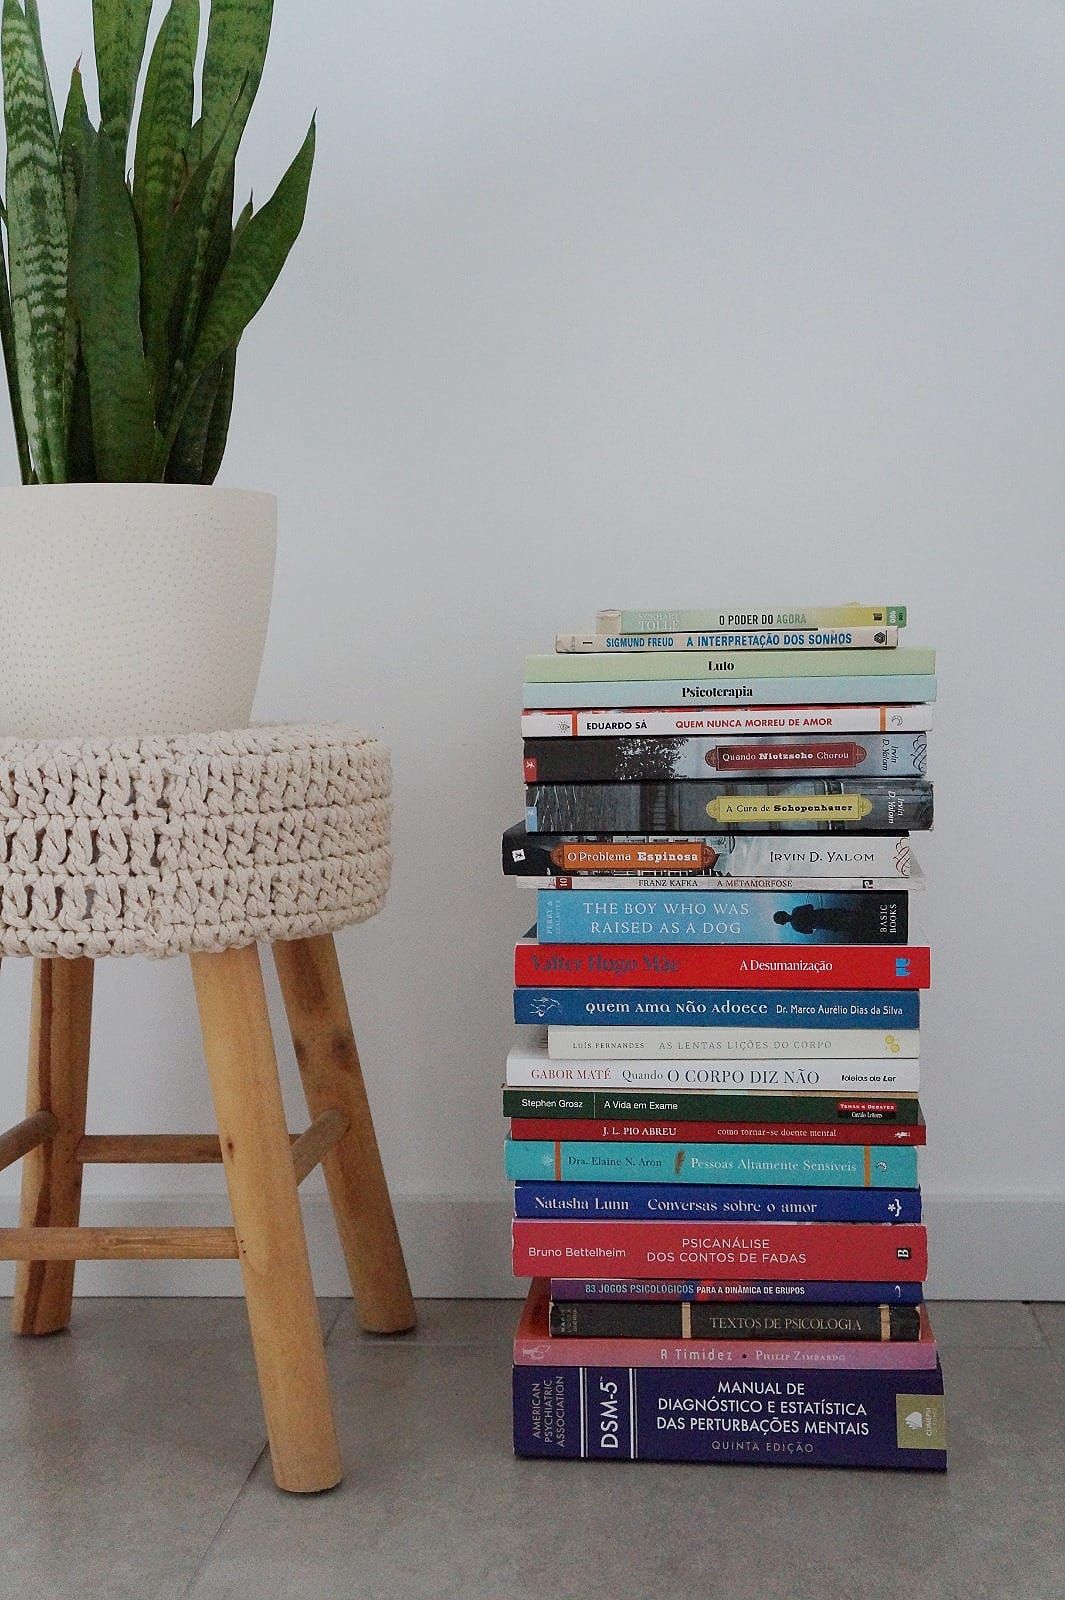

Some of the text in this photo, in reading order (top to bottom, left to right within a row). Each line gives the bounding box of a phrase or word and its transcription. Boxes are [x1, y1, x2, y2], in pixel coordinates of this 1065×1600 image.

[719, 613, 807, 625] O PODER DO AGORA
[606, 632, 852, 648] SIGMUND FREUD A INTERPRETAÇÃO DOS SONHOS
[708, 660, 735, 671] Luto
[682, 686, 753, 698] Psicoterapia
[586, 718, 647, 730] EDUARDO SÁ
[675, 717, 833, 729] QUEM NUNCA MORREU DE AMOR
[722, 749, 849, 763] Quando Nietzsche Chorou
[887, 792, 895, 800] D.
[726, 802, 853, 813] A Cura de Schopenhauer
[568, 849, 699, 862] O Problema Espinosa
[809, 850, 822, 863] D.
[726, 879, 793, 887] METAMORFOSE
[584, 902, 749, 914] THE BOY WHO WAS
[591, 922, 741, 934] RAISED AS A DOG
[740, 958, 833, 973] A Desumanização
[776, 1003, 903, 1016] Dr. Marco Aurélio Dias da Silva
[573, 1040, 592, 1049] LUÍS
[659, 1040, 832, 1051] AS LENTAS LIÇÕES DO CORPO
[531, 1067, 611, 1080] GABOR MATÉ
[622, 1067, 820, 1084] Quando O CORPO DIZ NÃO
[522, 1098, 583, 1110] Stephen Grosz
[604, 1100, 611, 1110] A
[613, 1100, 631, 1110] Vida
[650, 1101, 678, 1111] Exame
[602, 1126, 676, 1136] J. L. PIO ABREU
[810, 1128, 836, 1137] mental
[568, 1157, 662, 1167] Dra. Elaine N. Aron
[690, 1158, 856, 1172] Pessoas Altamente Sensíveis
[534, 1196, 629, 1210] Natasha Lunn
[648, 1198, 817, 1213] Conversas sobre o amor
[682, 1236, 770, 1249] PSICANÁLISE
[528, 1247, 626, 1258] Bruno Bettelheim
[647, 1252, 806, 1263] DOS CONTOS DE FADAS
[585, 1284, 596, 1294] 83
[598, 1283, 627, 1294] JOGOS
[696, 1285, 716, 1295] PARA
[718, 1285, 723, 1295] A
[725, 1283, 761, 1295] DINÂMICA
[764, 1285, 773, 1295] DE
[775, 1285, 805, 1295] GRUPOS
[710, 1317, 861, 1330] TEXTOS DE PSICOLOGIA
[660, 1349, 669, 1360] A
[675, 1348, 732, 1361] Timidez
[718, 1381, 804, 1396] MANUAL DE
[532, 1383, 541, 1438] AMERICAN
[543, 1380, 552, 1443] PSYCHIATRIC
[556, 1376, 565, 1447] ASSOCIATION
[658, 1395, 866, 1416] DIAGNÓSTICO E ESTATÍSTICA
[657, 1414, 869, 1435] DAS PERTURBAÇÕES MENTAIS
[711, 1440, 813, 1453] QUINTA EDIÇÃO
